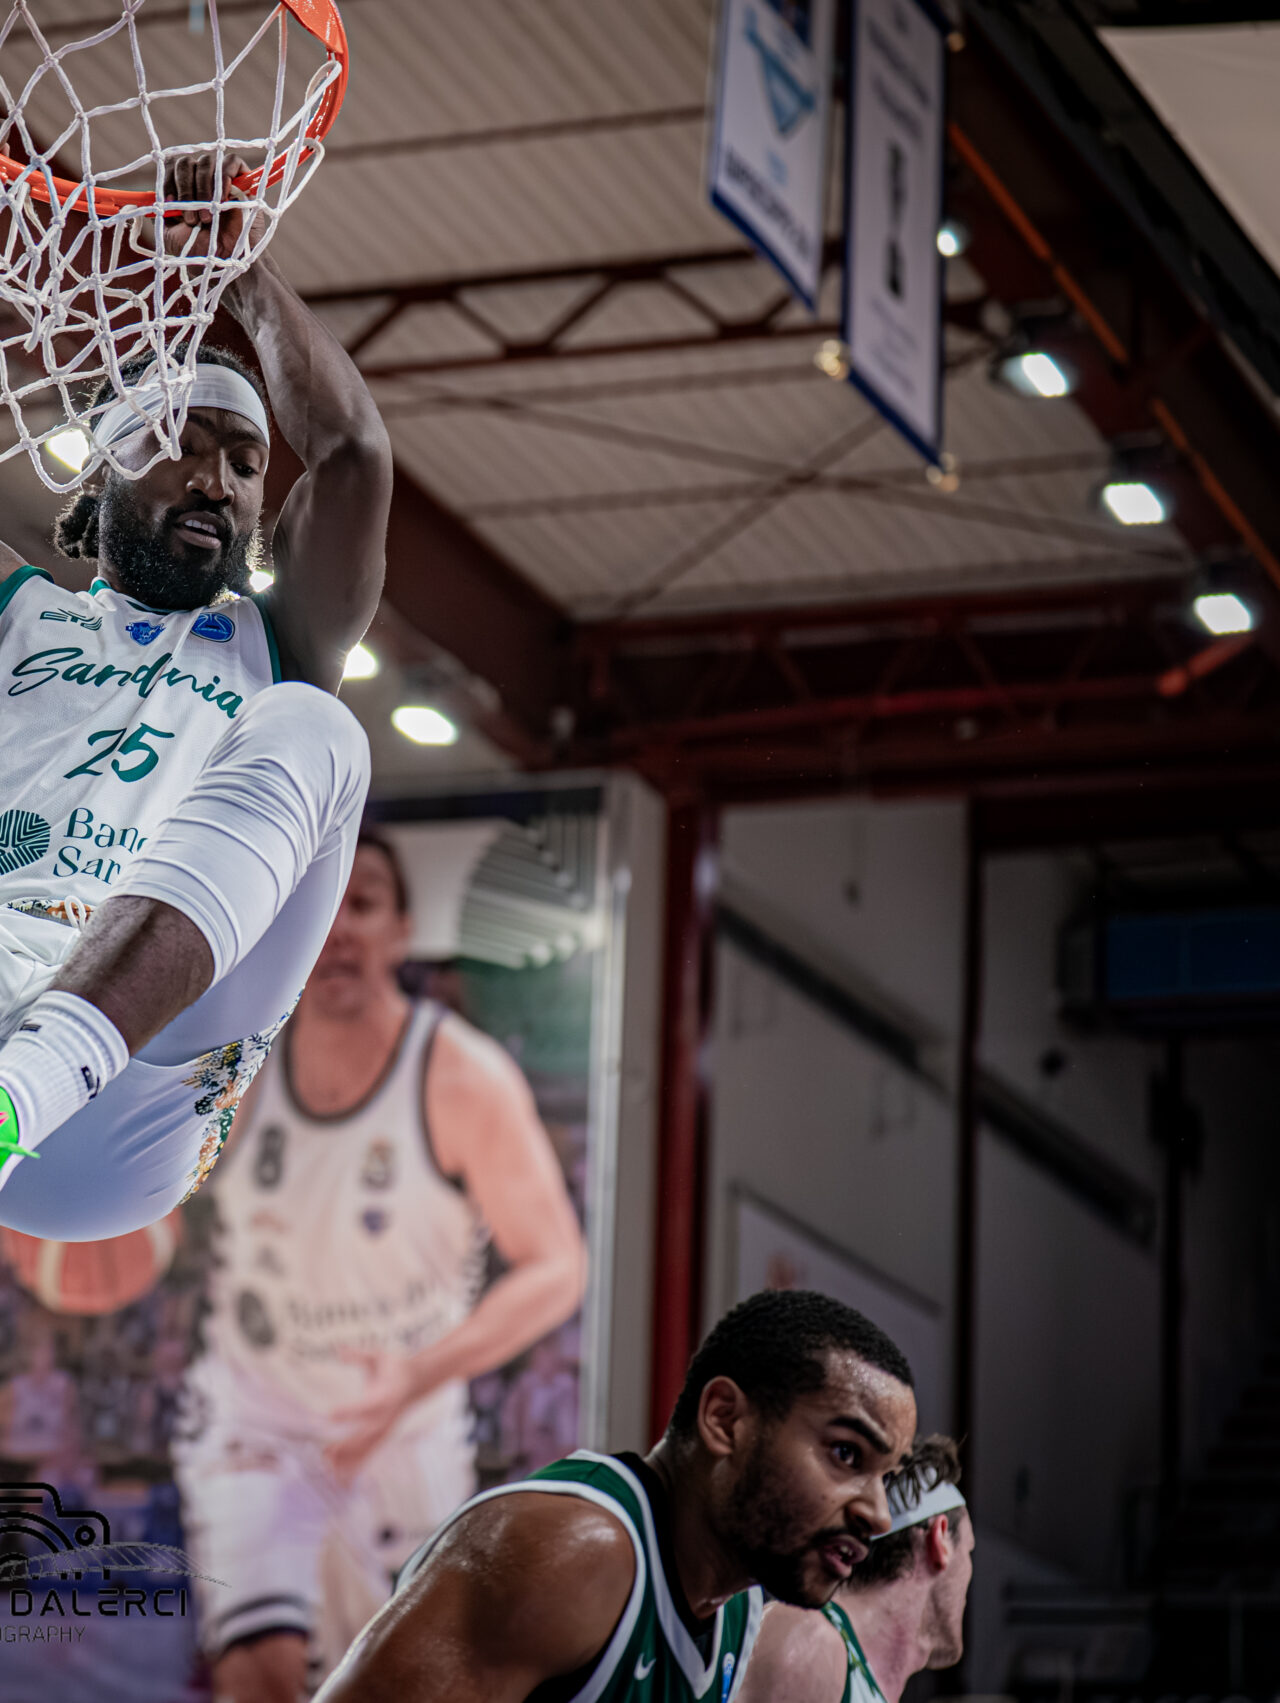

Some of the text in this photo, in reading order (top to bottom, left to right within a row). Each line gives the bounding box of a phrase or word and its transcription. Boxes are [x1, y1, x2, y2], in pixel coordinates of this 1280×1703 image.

[8, 646, 244, 719] Sardnia
[63, 722, 175, 783] 25
[52, 845, 121, 885] Sar
